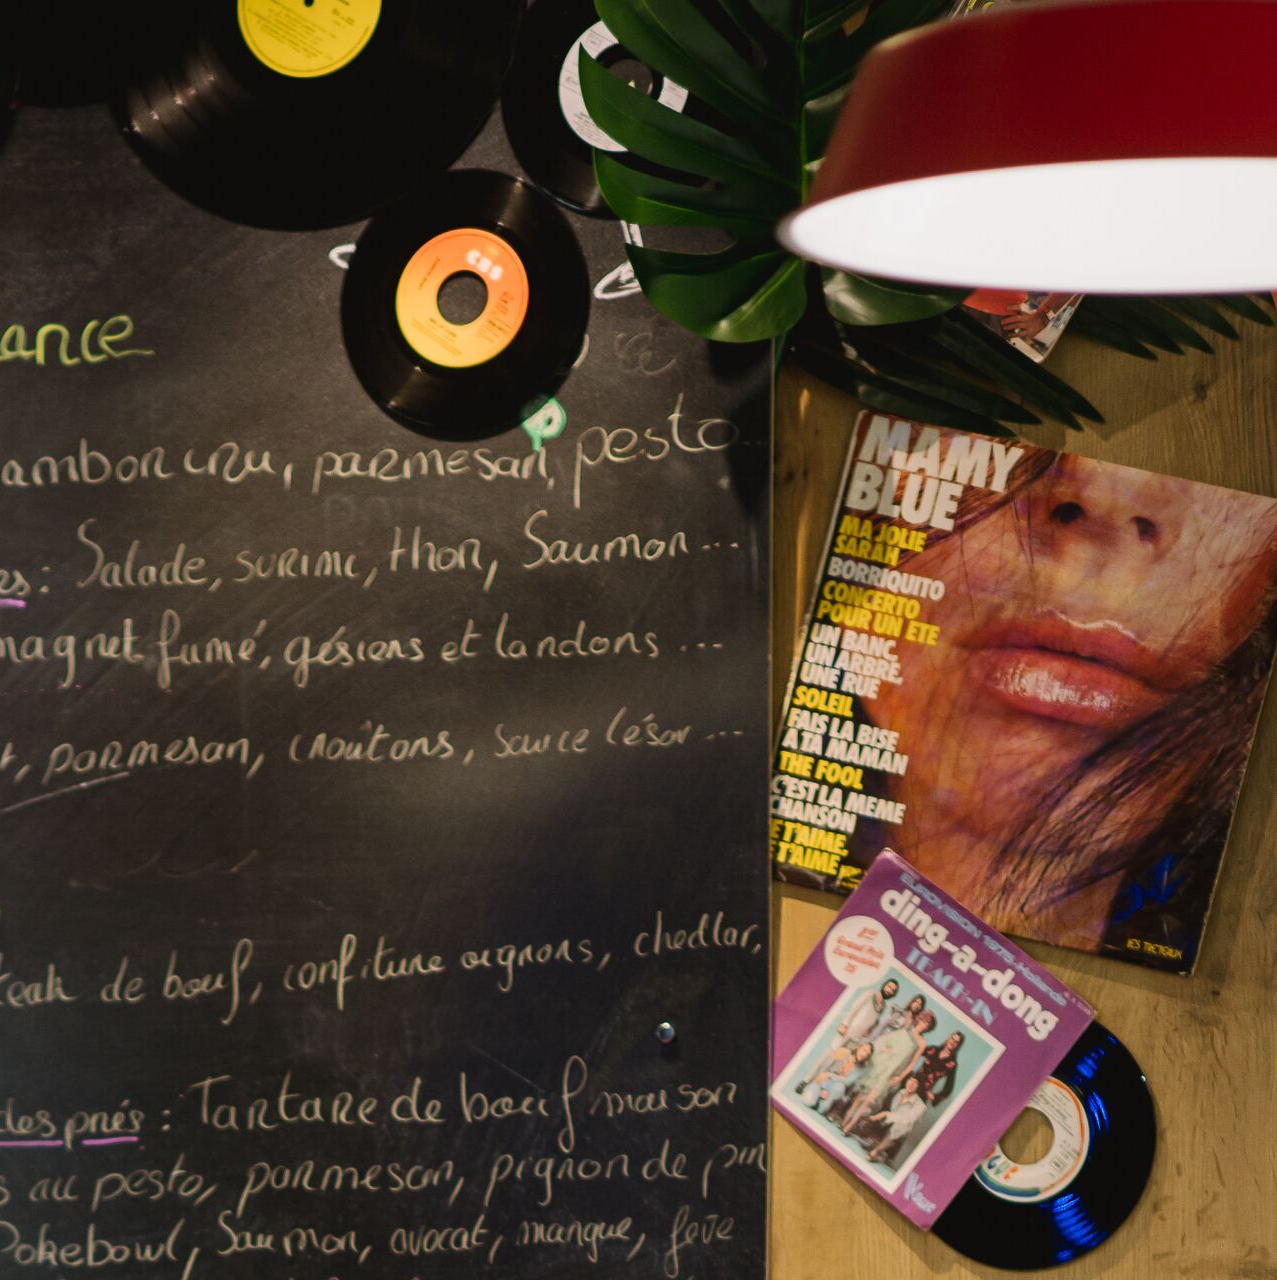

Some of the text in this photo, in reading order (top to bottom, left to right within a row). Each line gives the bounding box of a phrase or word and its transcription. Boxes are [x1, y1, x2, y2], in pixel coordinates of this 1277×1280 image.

[183, 440, 293, 492] cru,
[311, 442, 555, 495] parmesan,
[859, 414, 1025, 494] MAMY
[845, 462, 964, 533] BLUE
[75, 517, 225, 593] Salade,
[232, 545, 378, 592] surimi,
[390, 525, 499, 593] thon,
[833, 535, 900, 567] SARAH
[838, 515, 928, 553] MA JOLIE
[822, 579, 922, 619] CONCERTO
[826, 555, 947, 601] BORRIQUITO
[810, 622, 899, 661] UN BANC,
[816, 599, 942, 647] POUR UN ETE
[145, 609, 272, 691] fumé,
[441, 618, 486, 661] et
[804, 642, 904, 685] UN ARBRE,
[792, 685, 854, 718] SOLEIL
[799, 661, 881, 700] UNE RUE
[781, 727, 909, 775] A TA MAMAN
[787, 706, 899, 752] FAIS LA BISE
[42, 738, 264, 786] parmesan,
[493, 729, 589, 760] sauce
[777, 750, 864, 790] THE FOOL
[772, 774, 906, 825] C'EST LA MEME
[101, 953, 148, 1005] de
[282, 931, 447, 1012] confiture
[879, 888, 1060, 1042] ding-a-dong
[189, 1071, 378, 1132] Tartare
[390, 1077, 444, 1126] de
[590, 1080, 739, 1114] maison
[28, 1176, 77, 1202] au
[91, 1152, 216, 1213] pesto,
[238, 1158, 464, 1218] parmesan,
[488, 1150, 629, 1206] pignon
[641, 1138, 689, 1181] de
[217, 1210, 373, 1262] Saumon,
[388, 1206, 503, 1263] avocat,
[516, 1214, 647, 1260] mangue,
